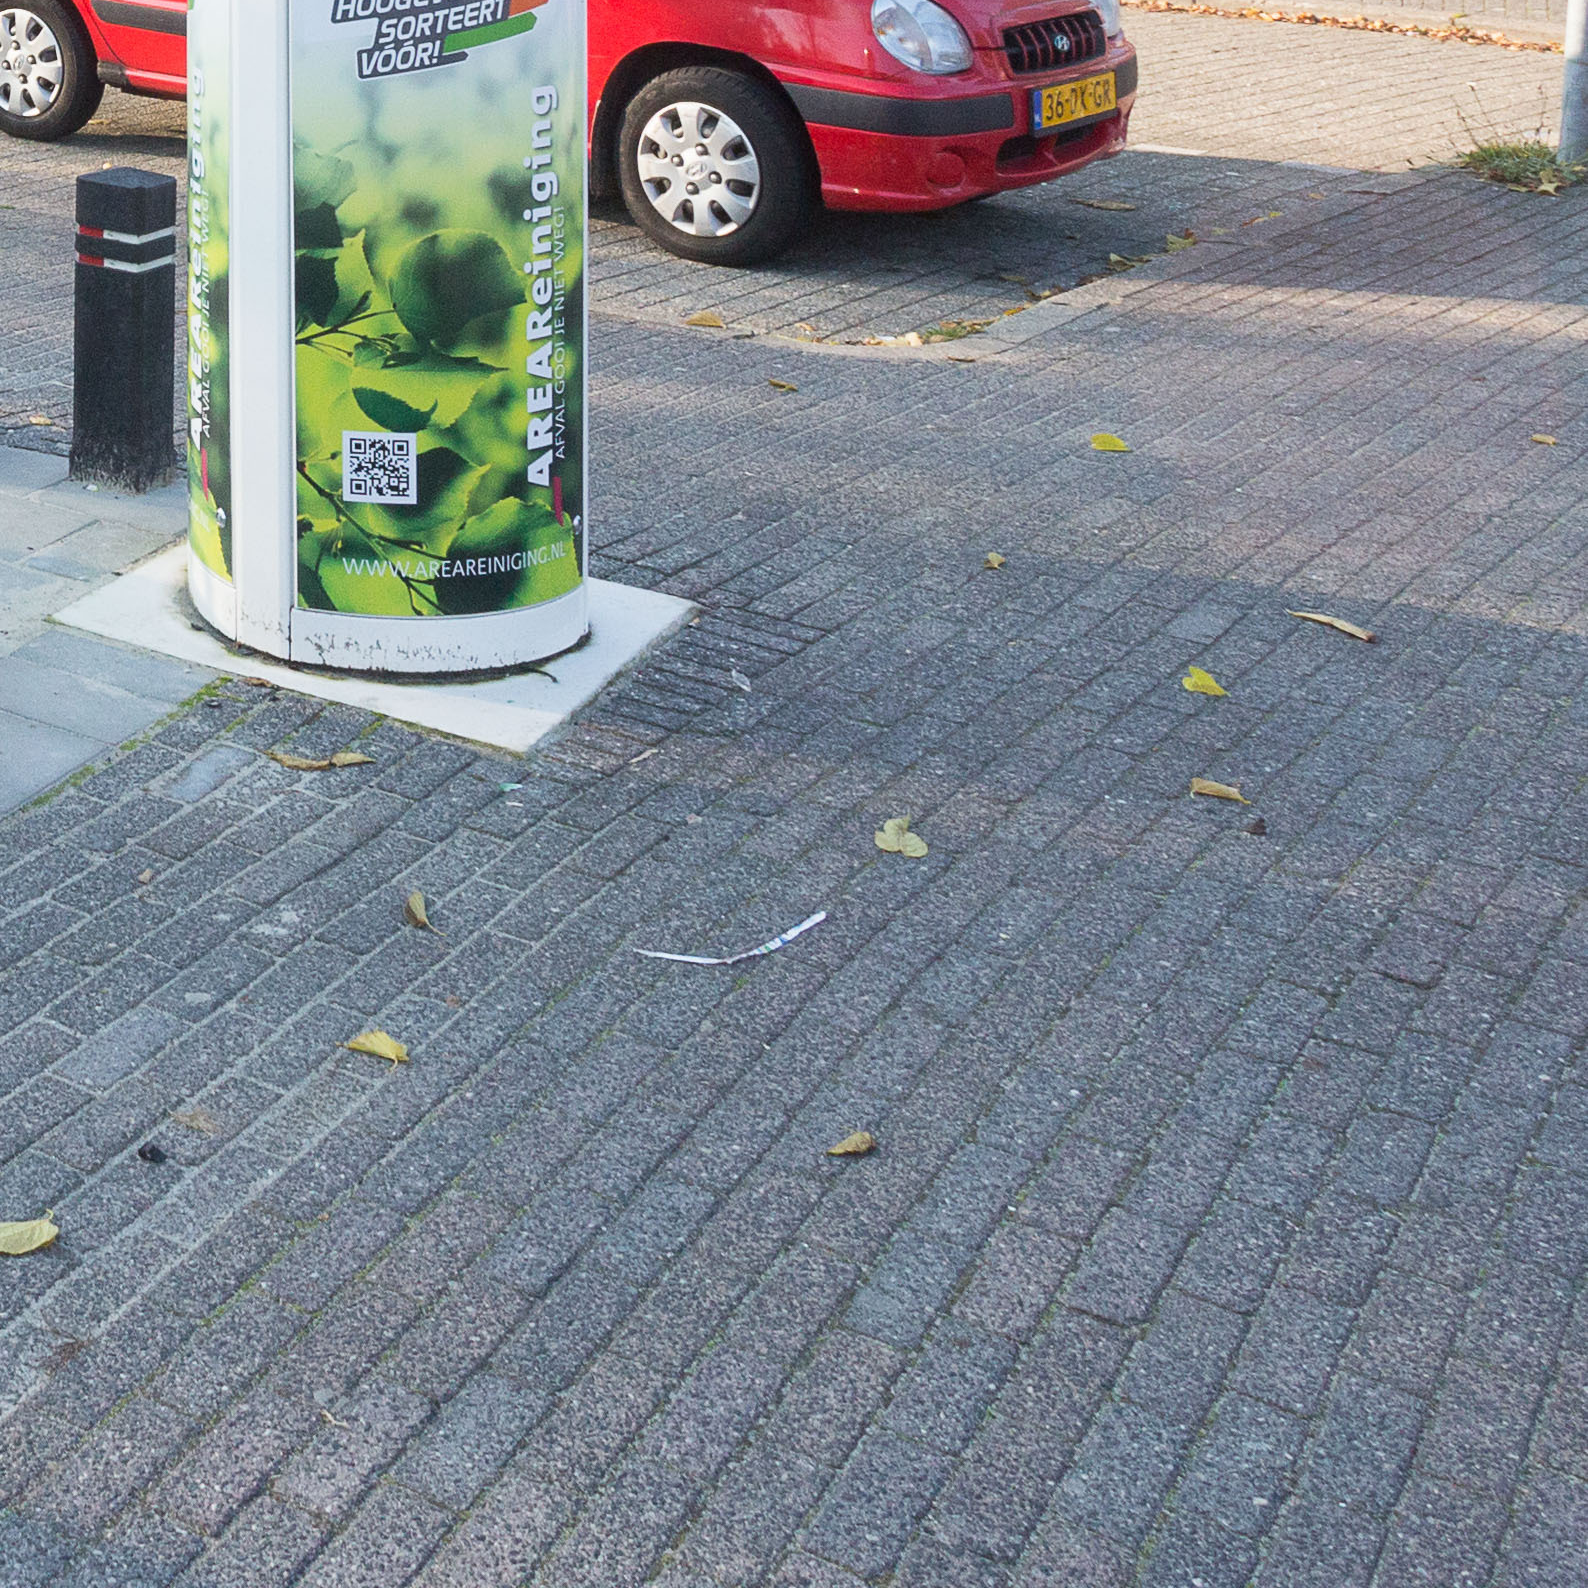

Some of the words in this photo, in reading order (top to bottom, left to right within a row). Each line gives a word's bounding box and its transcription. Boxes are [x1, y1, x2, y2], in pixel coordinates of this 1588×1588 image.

[360, 39, 442, 76] VÓÓR!
[553, 205, 565, 262] WEG!
[524, 85, 559, 487] AREAReiniging
[554, 268, 565, 311] NIET
[554, 315, 565, 335] JE
[554, 341, 566, 395] GOOI
[554, 398, 566, 459] AFVAL
[342, 540, 566, 579] WWW.AREAREINIGING.NL
